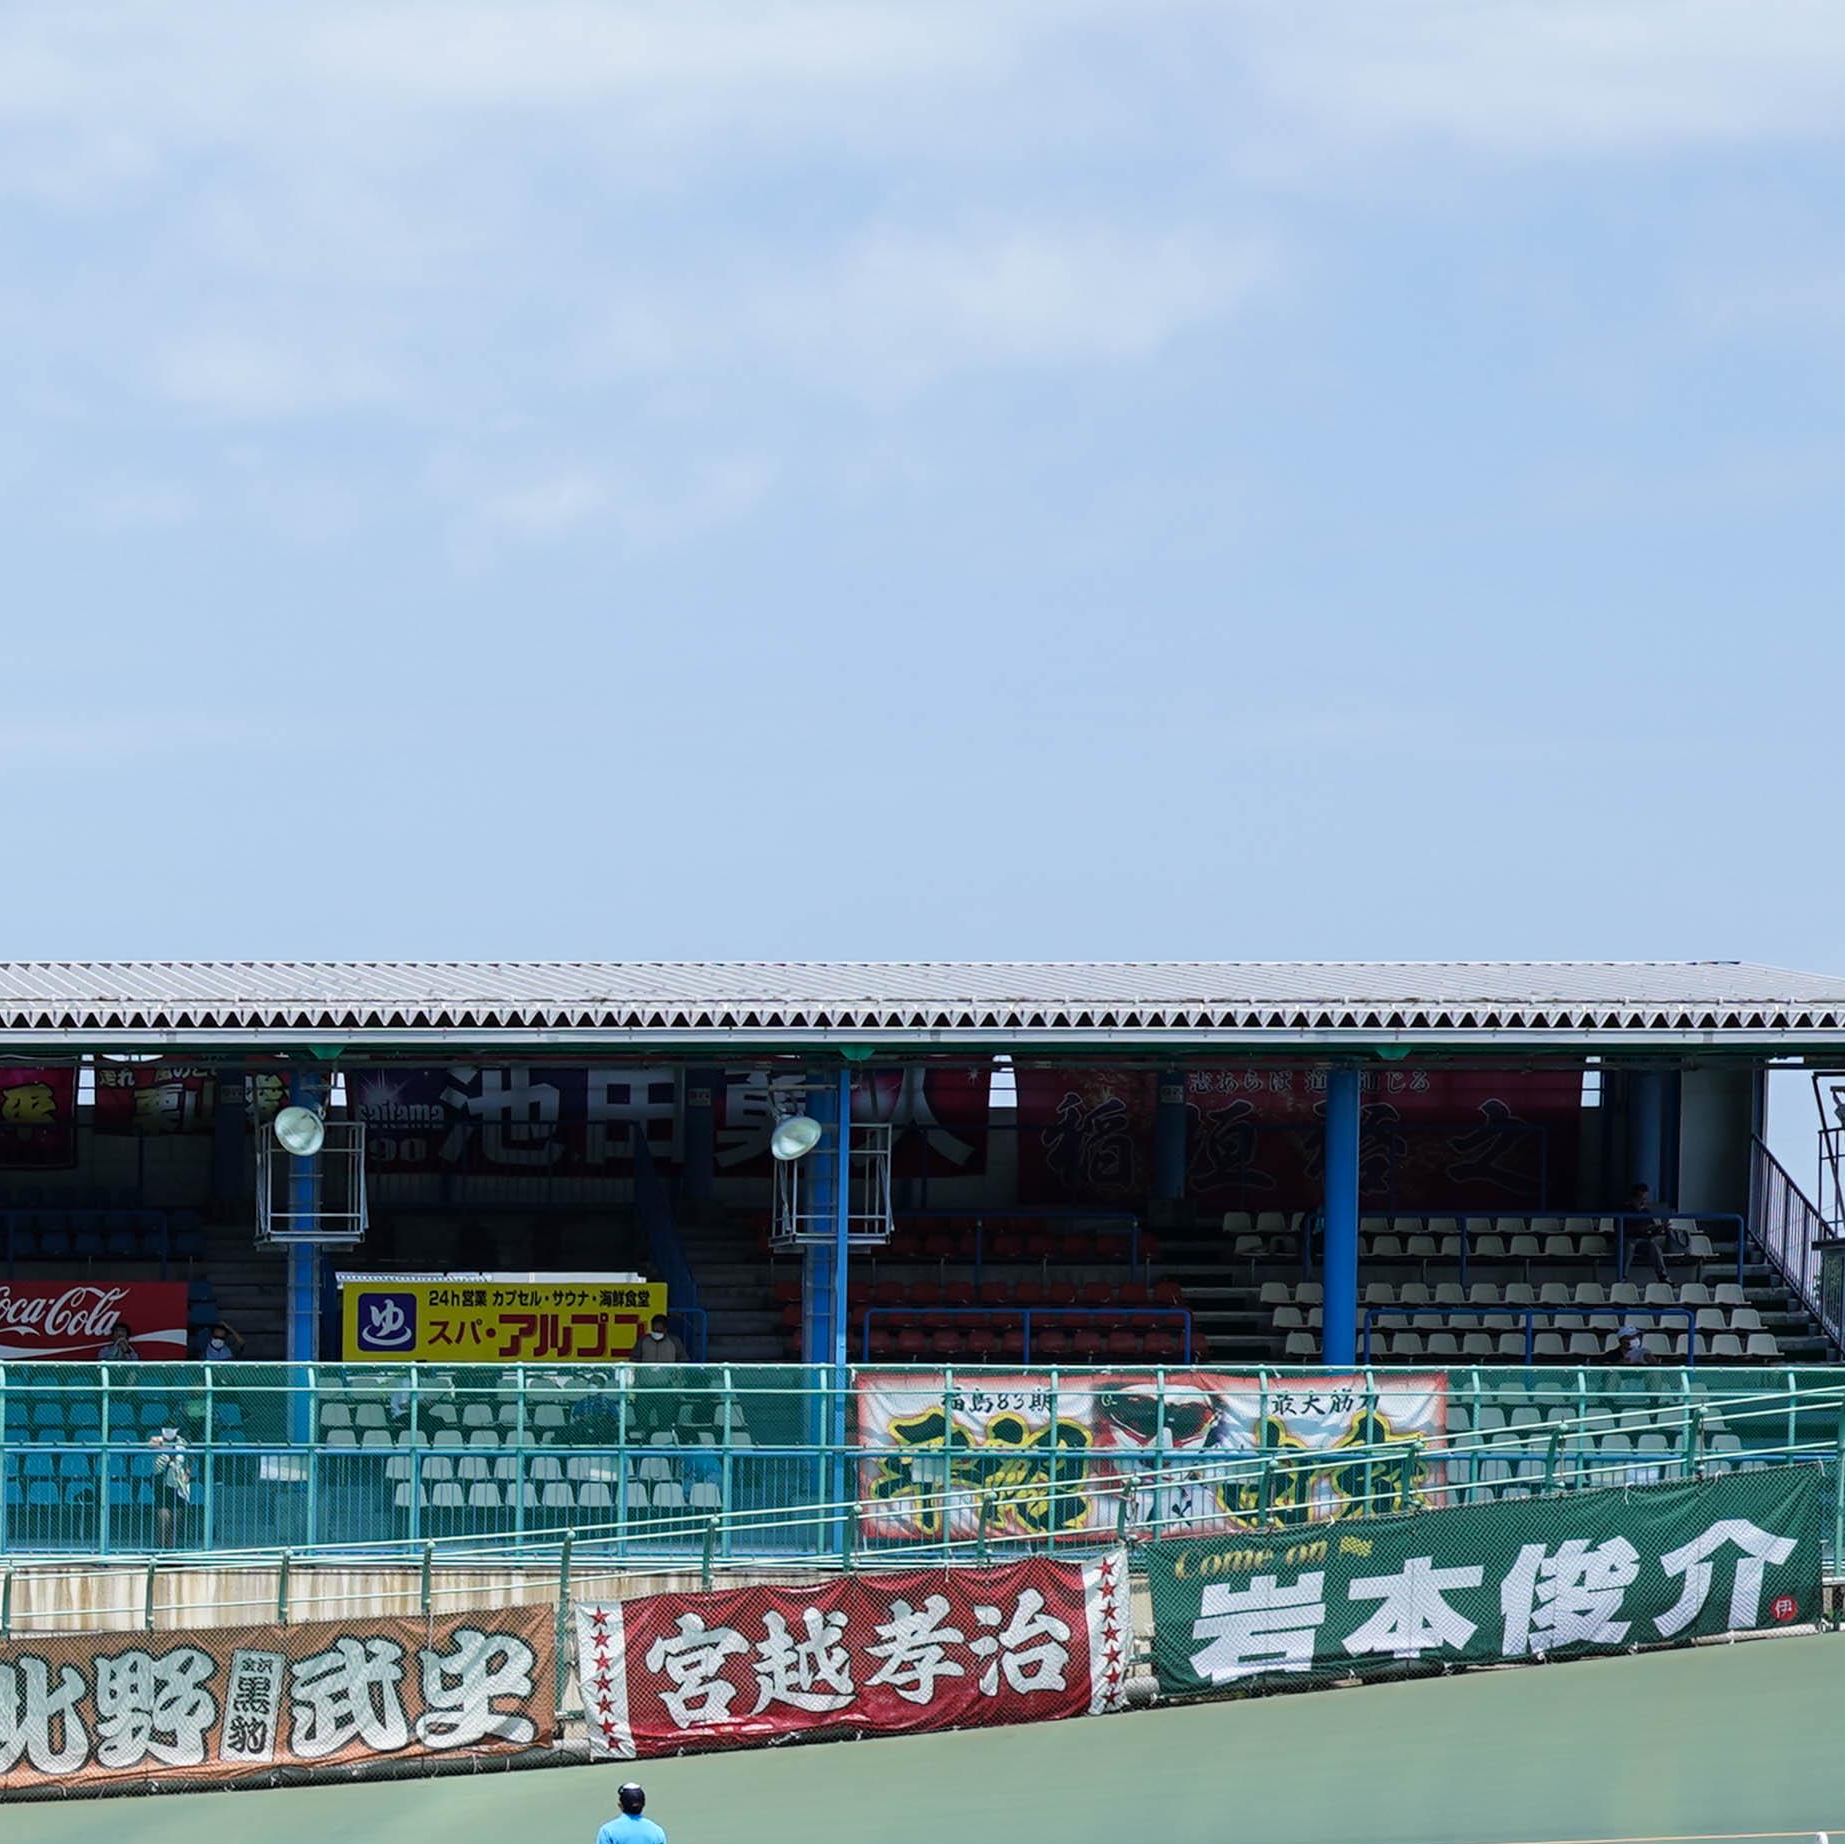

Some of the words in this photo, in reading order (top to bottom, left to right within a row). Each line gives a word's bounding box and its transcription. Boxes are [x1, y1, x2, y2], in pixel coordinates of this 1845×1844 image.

[645, 1588, 1073, 1730] 宮越孝治
[1189, 1518, 1798, 1684] 岩本俊介
[288, 1628, 542, 1760] 武史
